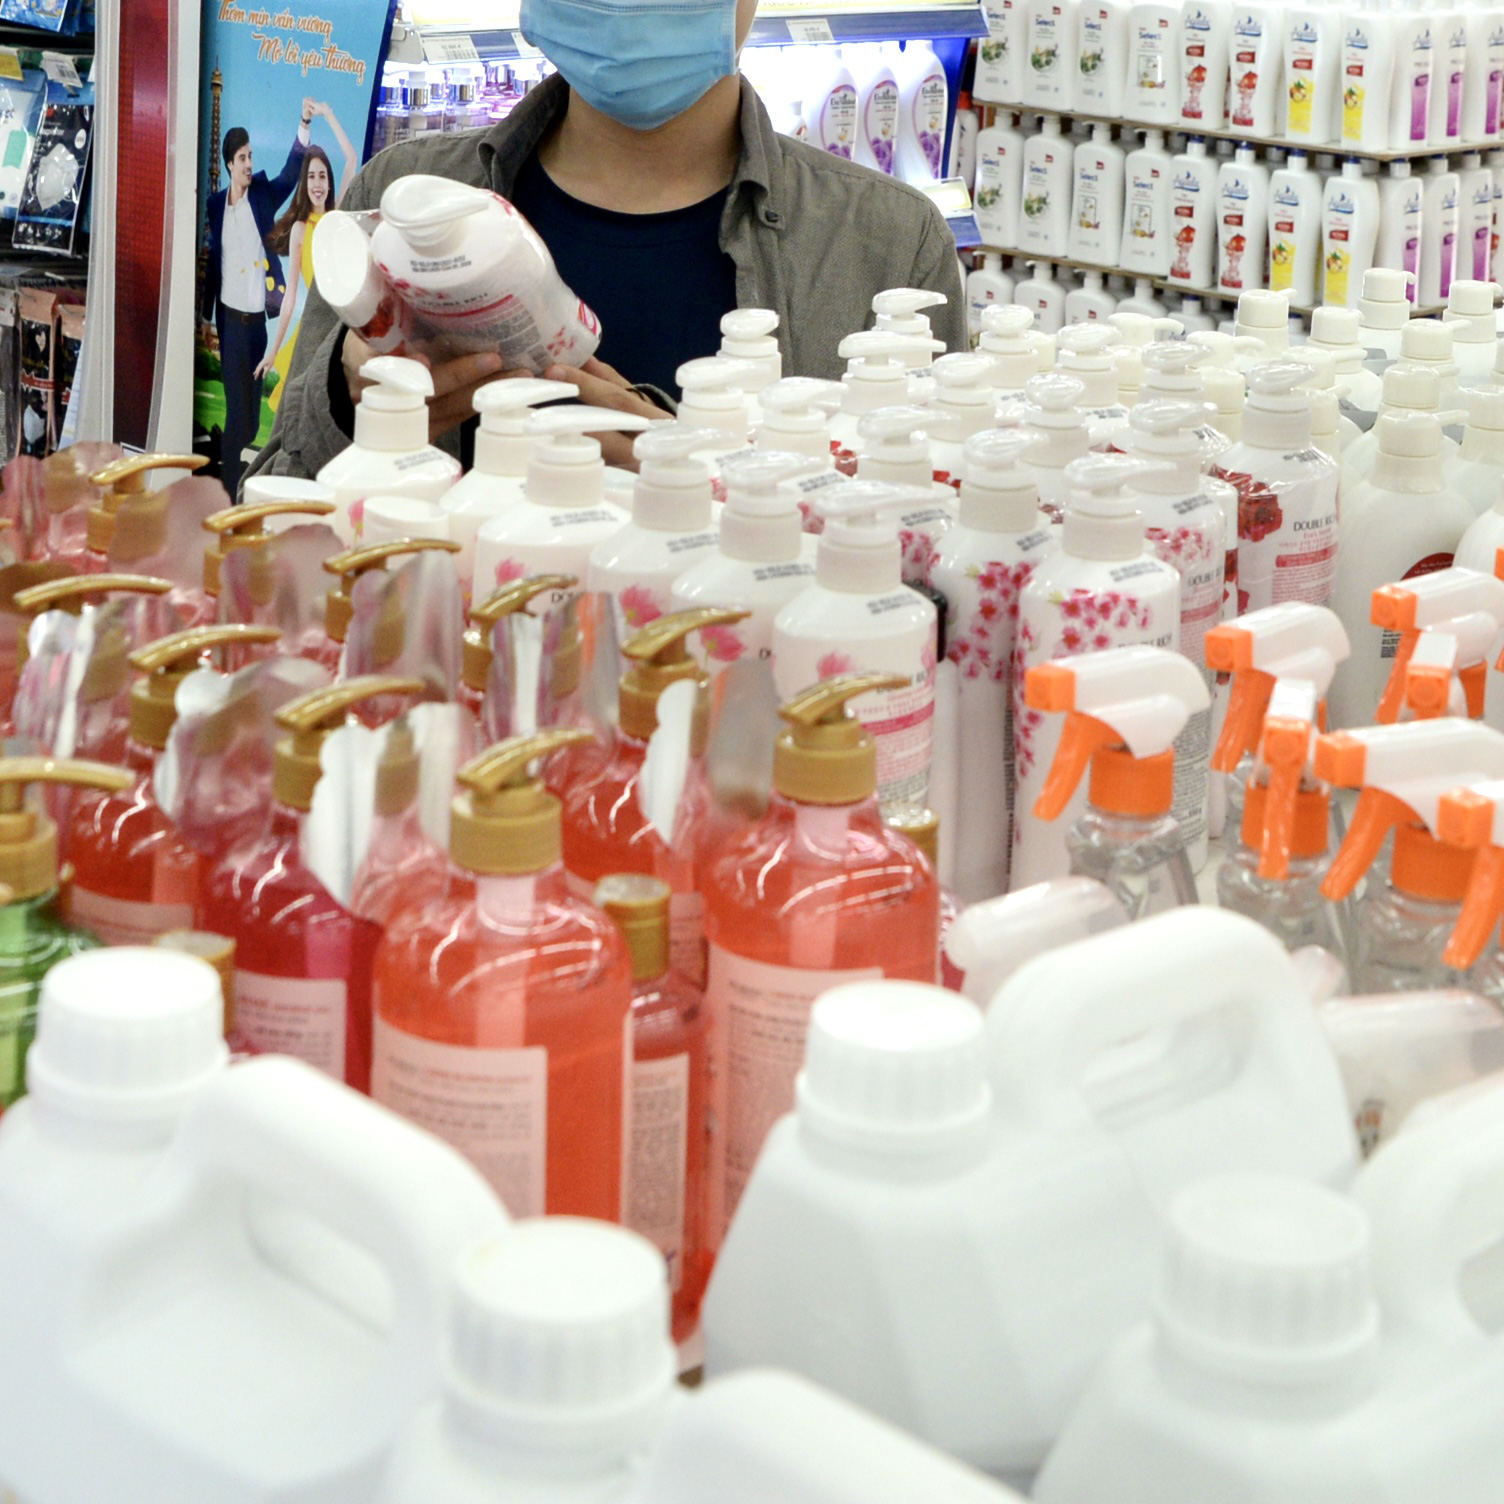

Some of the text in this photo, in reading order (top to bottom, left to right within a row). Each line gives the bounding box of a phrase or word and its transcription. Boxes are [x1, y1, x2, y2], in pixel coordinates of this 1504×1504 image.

[248, 9, 269, 31] mịn
[296, 14, 333, 44] vương
[300, 51, 322, 77] yêu
[322, 45, 365, 84] thương
